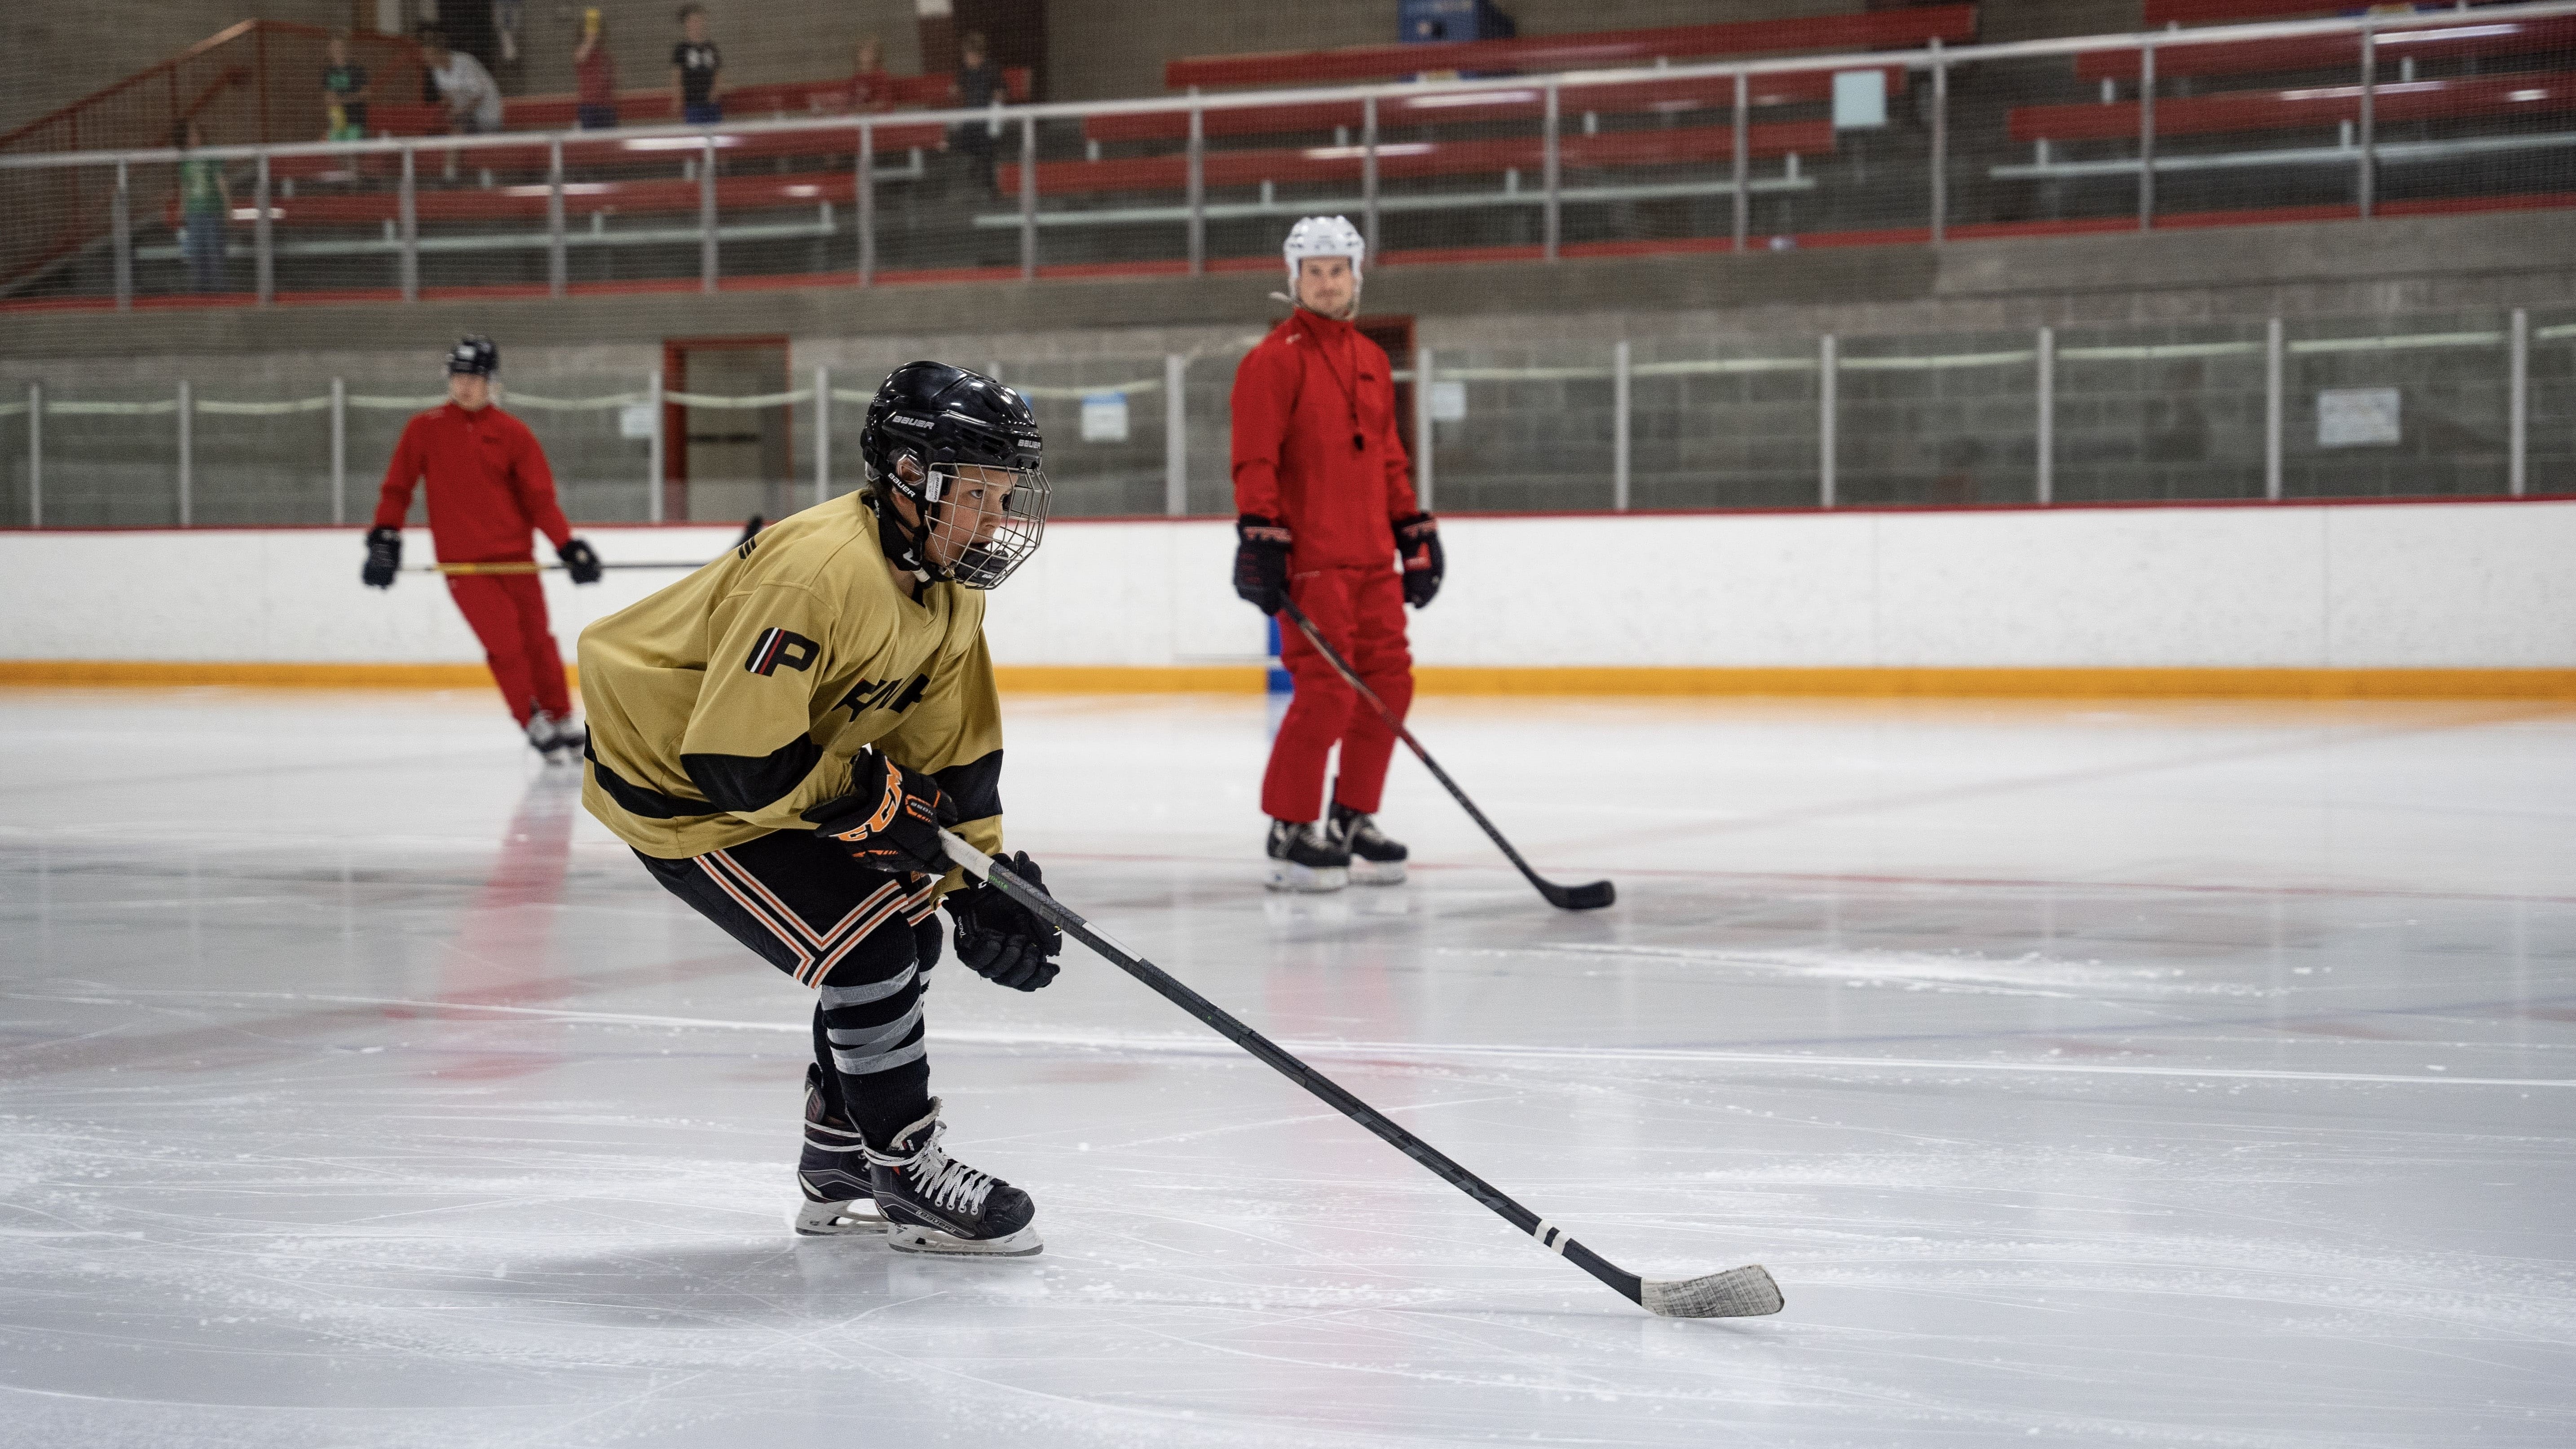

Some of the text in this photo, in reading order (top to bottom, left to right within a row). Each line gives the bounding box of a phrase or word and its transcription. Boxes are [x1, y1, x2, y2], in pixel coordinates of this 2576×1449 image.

[892, 415, 935, 429] BAUER
[1018, 439, 1041, 449] BAUER
[888, 473, 916, 498] BAUER
[829, 755, 902, 841] CCM
[958, 916, 966, 936] TACKS
[1349, 1107, 1509, 1210] CCM
